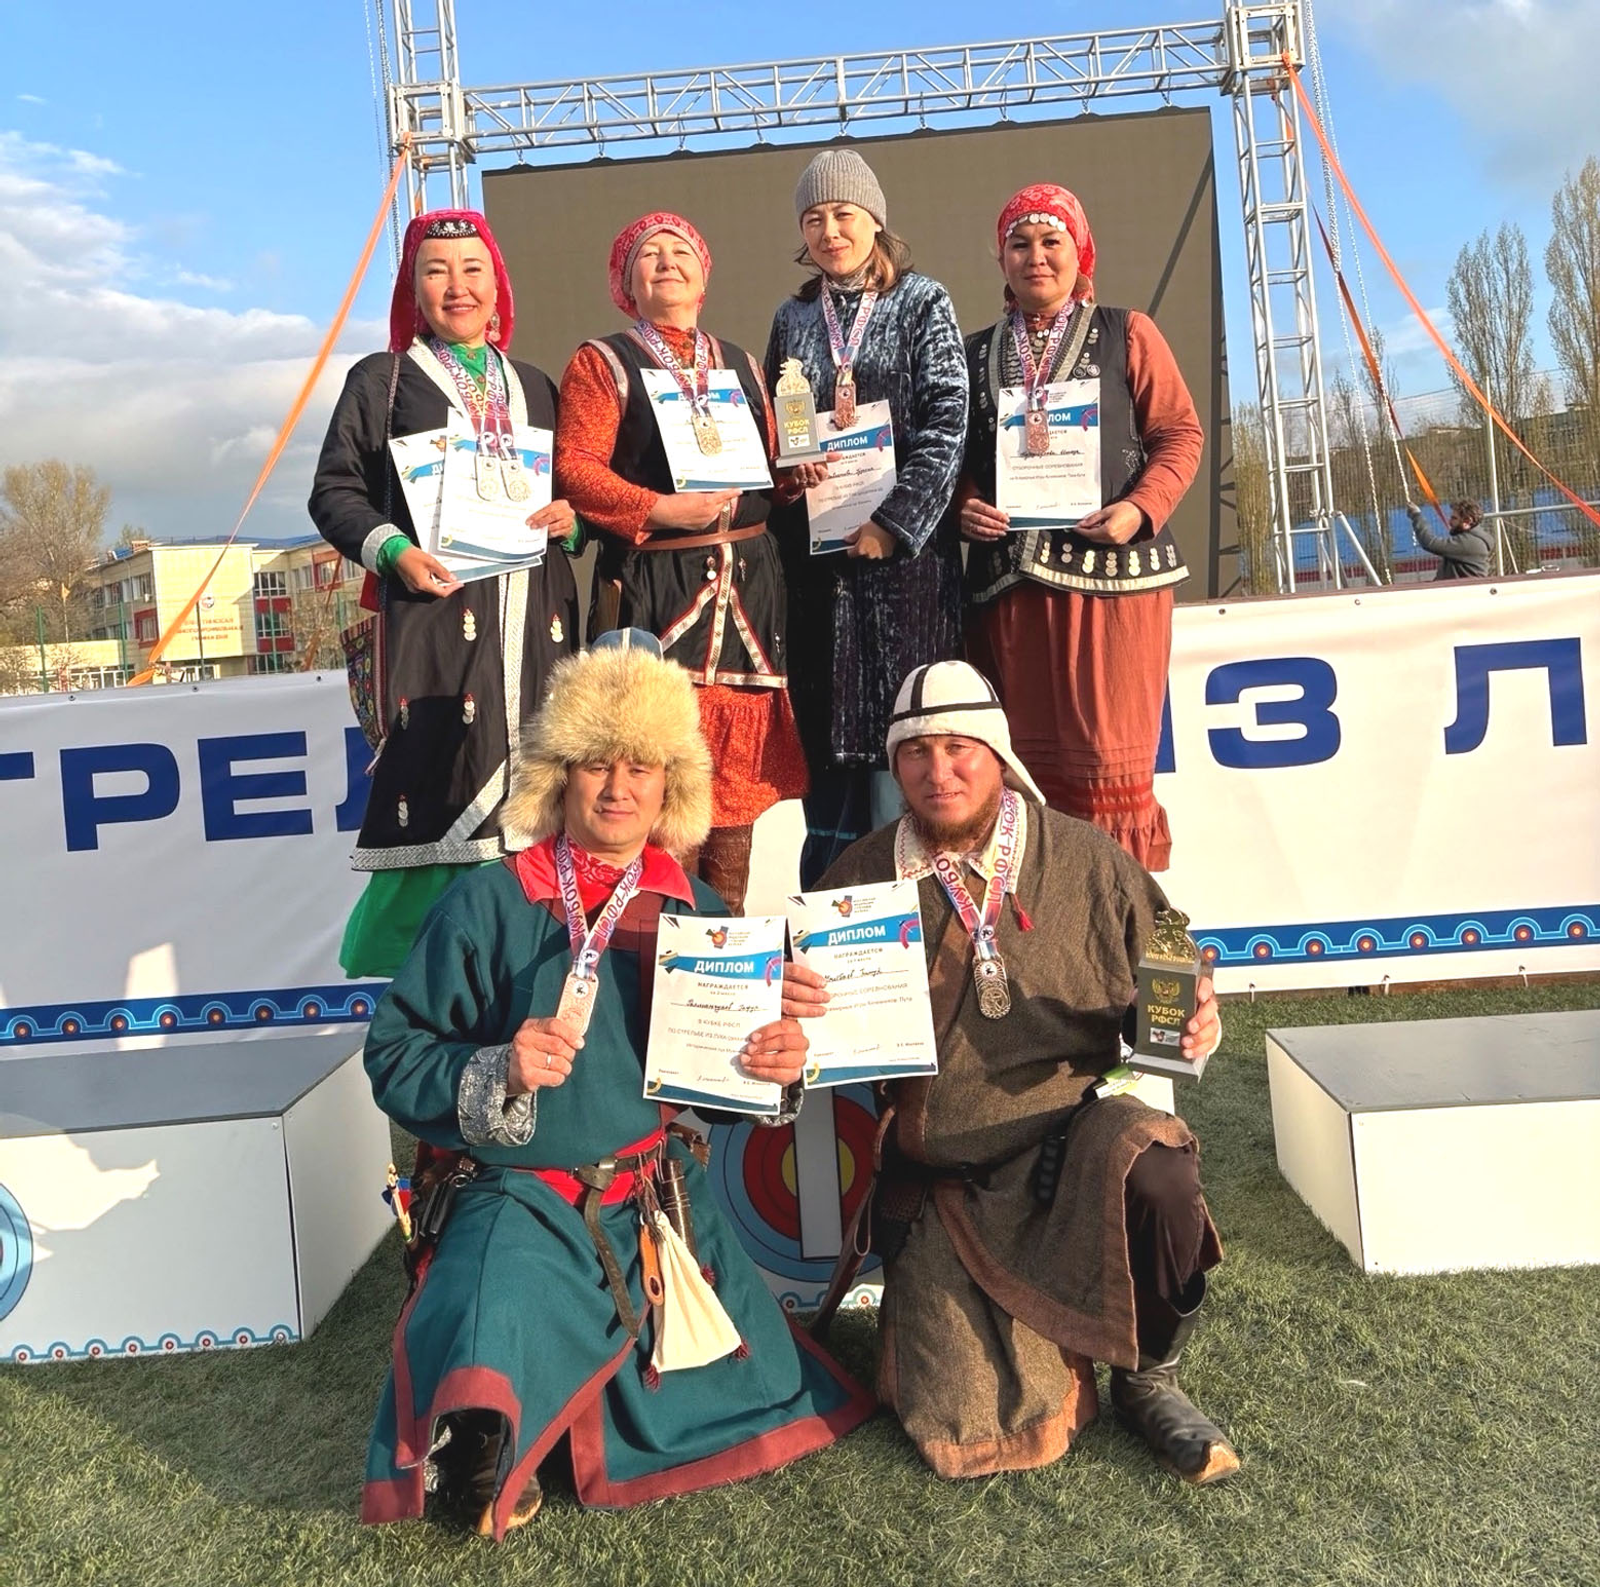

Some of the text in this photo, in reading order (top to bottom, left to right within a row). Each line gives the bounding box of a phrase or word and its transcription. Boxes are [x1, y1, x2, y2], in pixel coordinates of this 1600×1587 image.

[784, 419, 810, 428] КУБОК
[827, 436, 868, 451] ДИПЛОМ
[1154, 656, 1341, 774] З
[987, 845, 1011, 902] РФСЛ
[556, 837, 586, 938] КУБОК РФС
[935, 853, 974, 910] КУБО
[594, 861, 642, 939] БОК РФСЛ
[828, 925, 886, 945] ДИПЛОМ
[834, 948, 883, 958] НАГРАЖДАЕТСЯ
[694, 960, 754, 973] ДИПЛОМ
[697, 982, 749, 990] НАГРАЖДАЕТСЯ
[1147, 1004, 1185, 1018] КУБОК
[1151, 1015, 1181, 1026] РФСЛ
